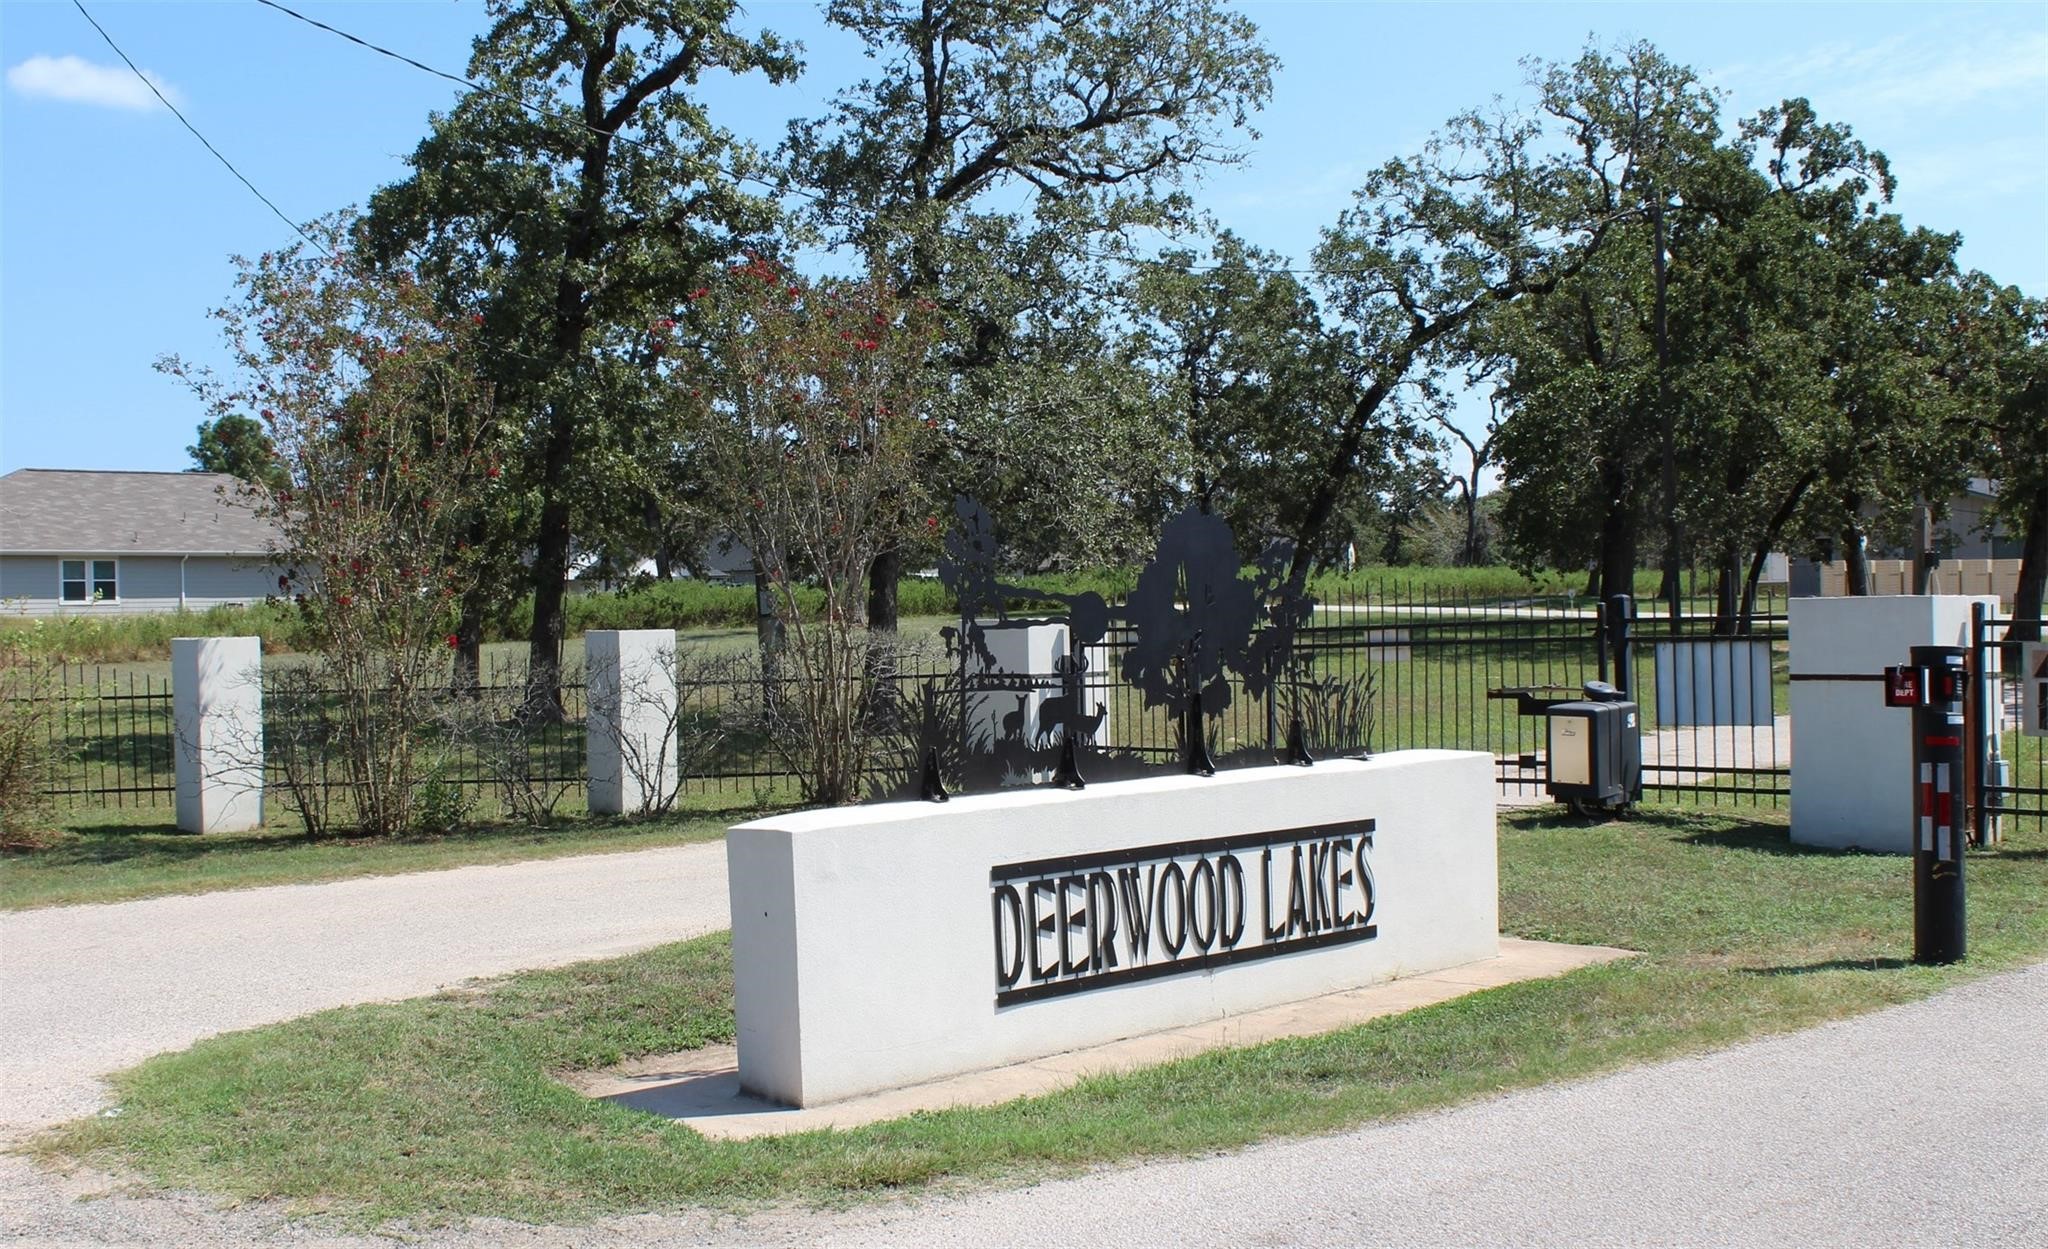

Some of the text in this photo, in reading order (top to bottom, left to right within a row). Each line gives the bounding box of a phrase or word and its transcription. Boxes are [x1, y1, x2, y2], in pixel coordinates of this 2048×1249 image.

[1895, 689, 1914, 697] DEPT
[994, 836, 1375, 987] DEERWOOD LAKES
